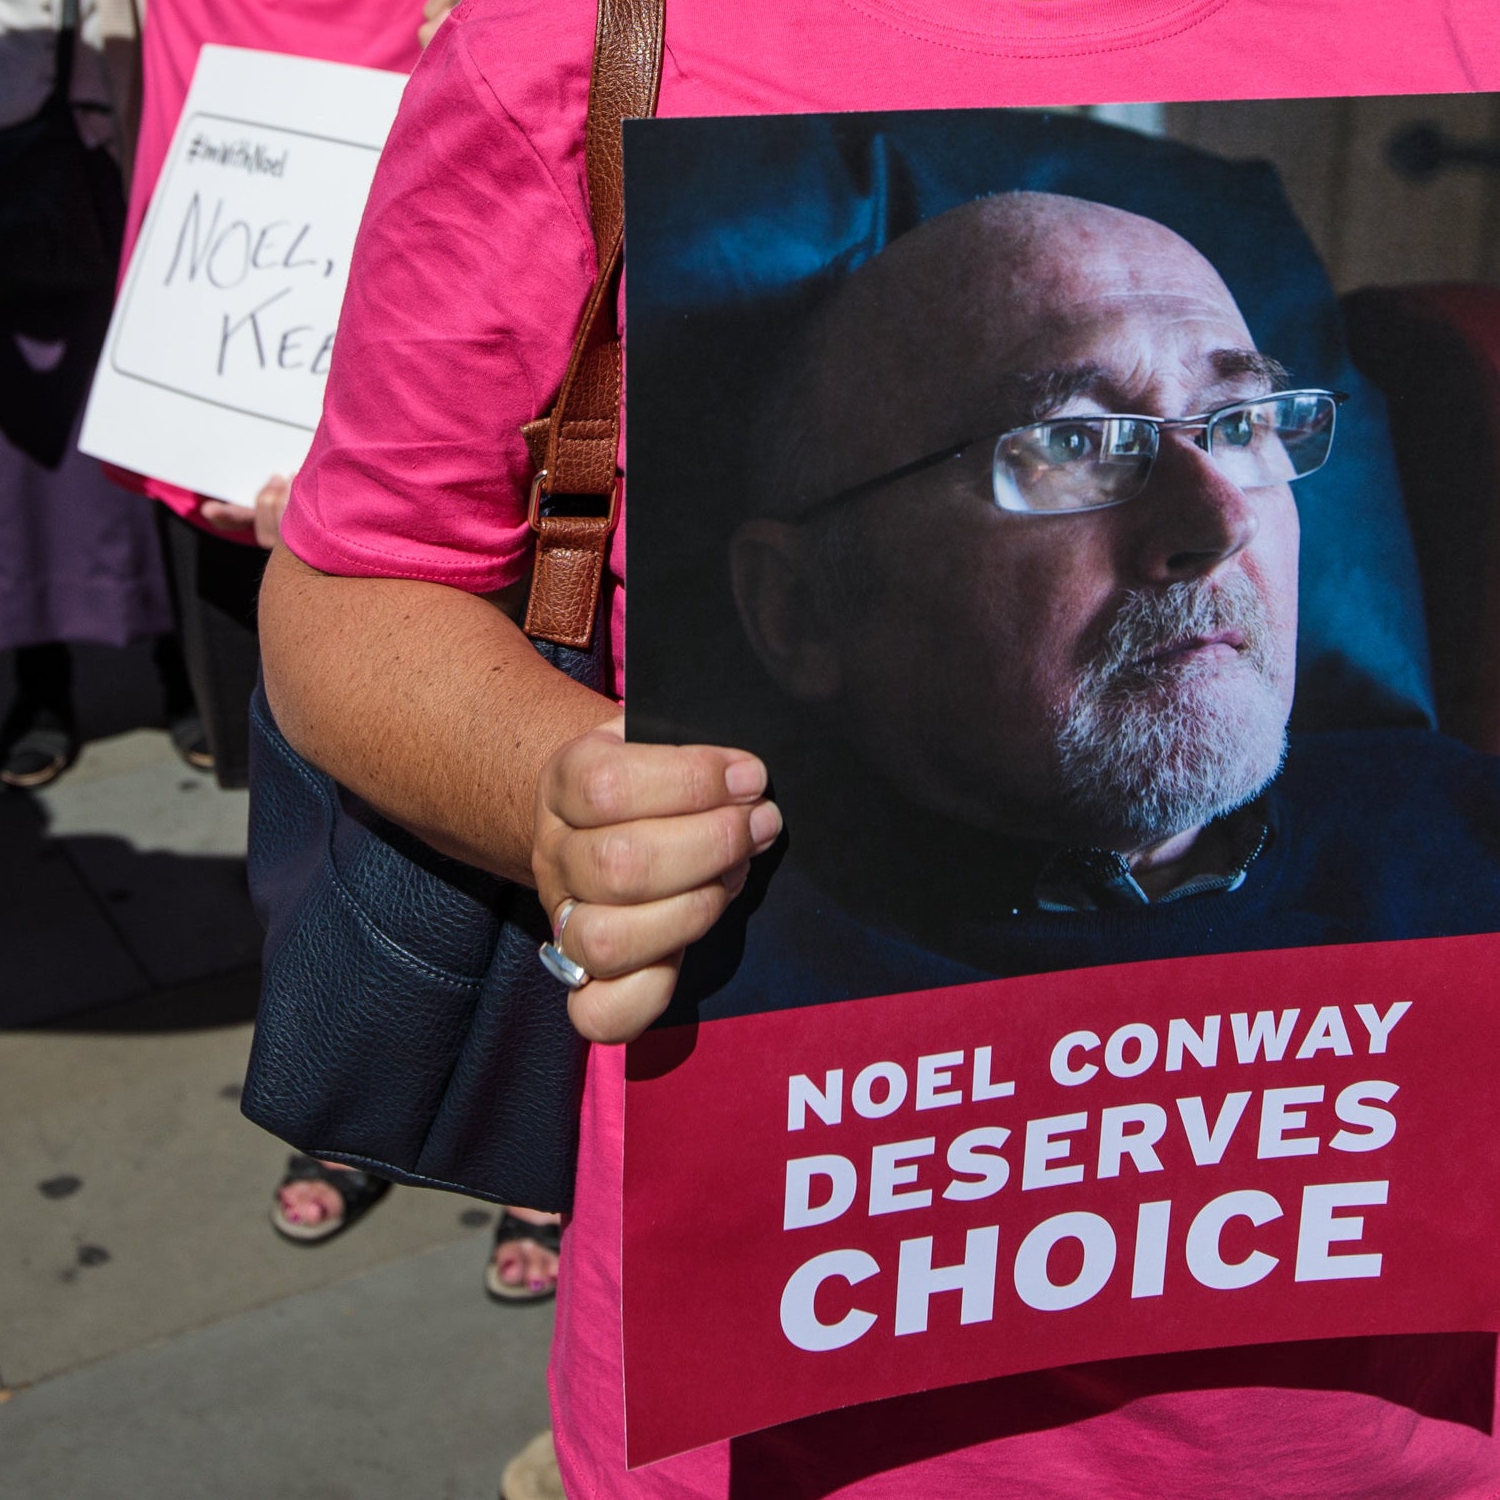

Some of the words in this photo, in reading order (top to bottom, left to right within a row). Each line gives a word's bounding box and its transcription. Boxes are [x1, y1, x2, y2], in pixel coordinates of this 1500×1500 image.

[163, 192, 336, 289] NOEL,
[787, 1045, 1015, 1131] NOEL
[1049, 1001, 1413, 1087] CONWAY
[783, 1080, 1400, 1231] DESERVES
[779, 1180, 1389, 1352] CHOICE
